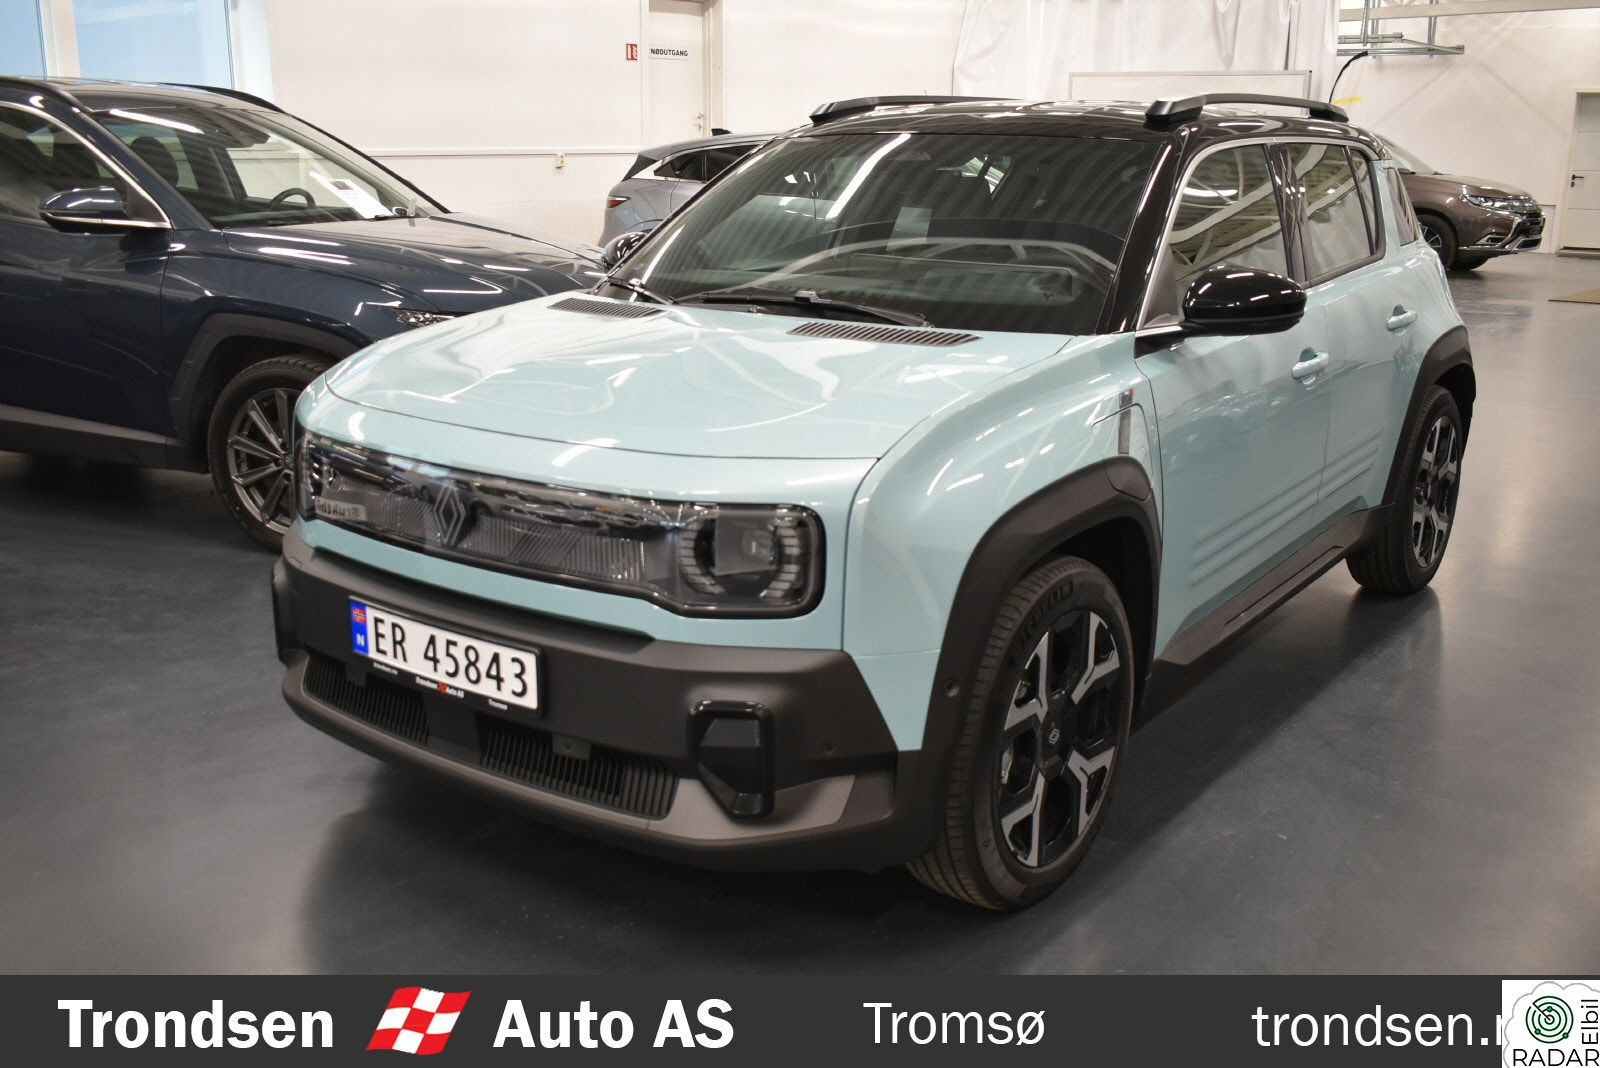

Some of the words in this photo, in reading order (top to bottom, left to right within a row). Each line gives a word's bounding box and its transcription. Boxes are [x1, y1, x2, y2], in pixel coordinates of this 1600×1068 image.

[650, 48, 688, 56] NØDUTGANG
[356, 633, 365, 646] N
[373, 615, 408, 663] ER
[423, 633, 528, 698] 45843
